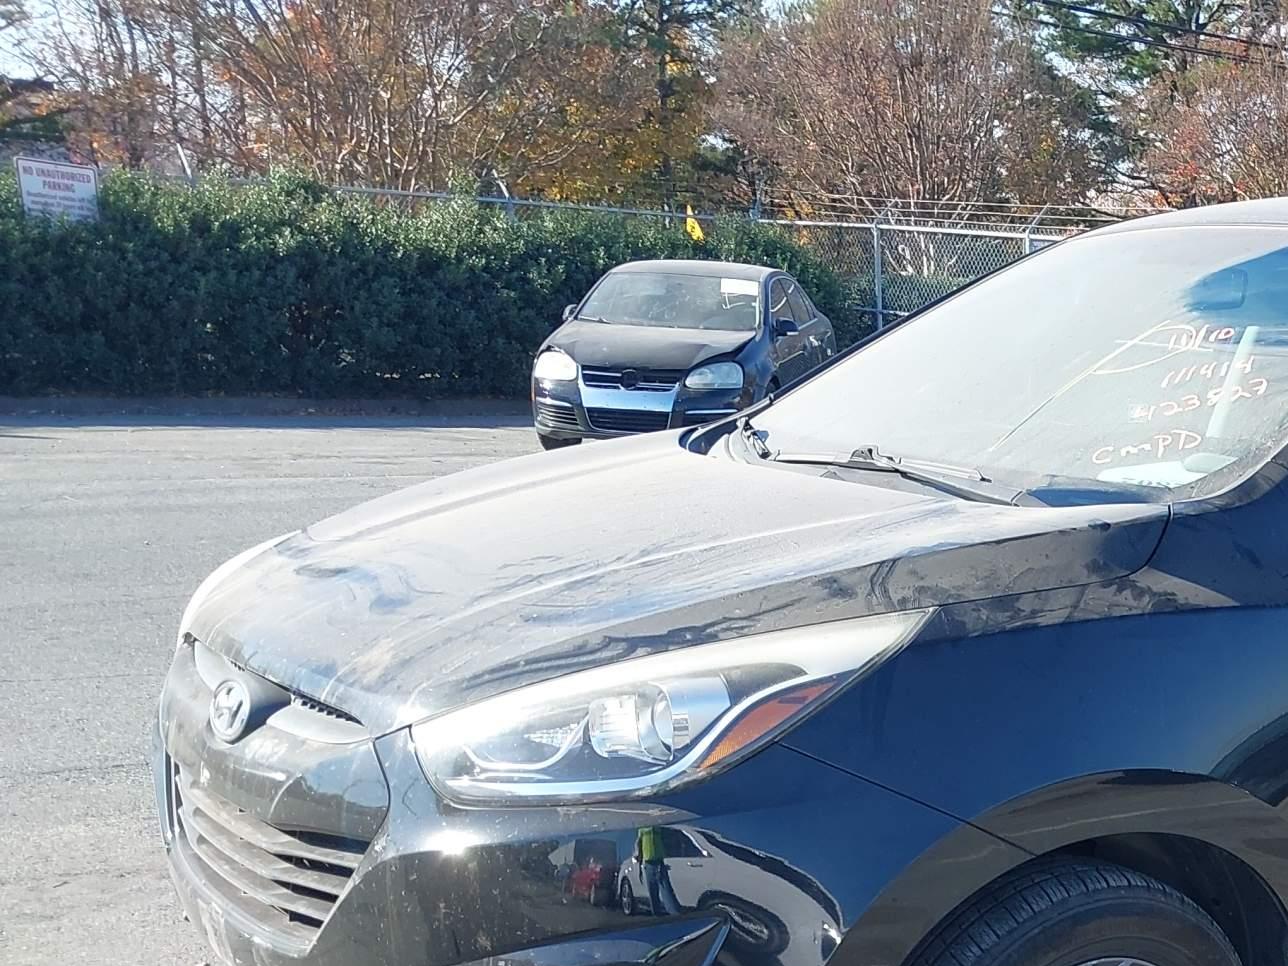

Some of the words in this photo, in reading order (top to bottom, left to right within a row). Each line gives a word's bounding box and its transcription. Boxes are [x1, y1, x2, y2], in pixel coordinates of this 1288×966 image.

[22, 165, 34, 176] NO
[35, 167, 91, 183] UNAUTHORIZED
[42, 180, 76, 193] PARKING
